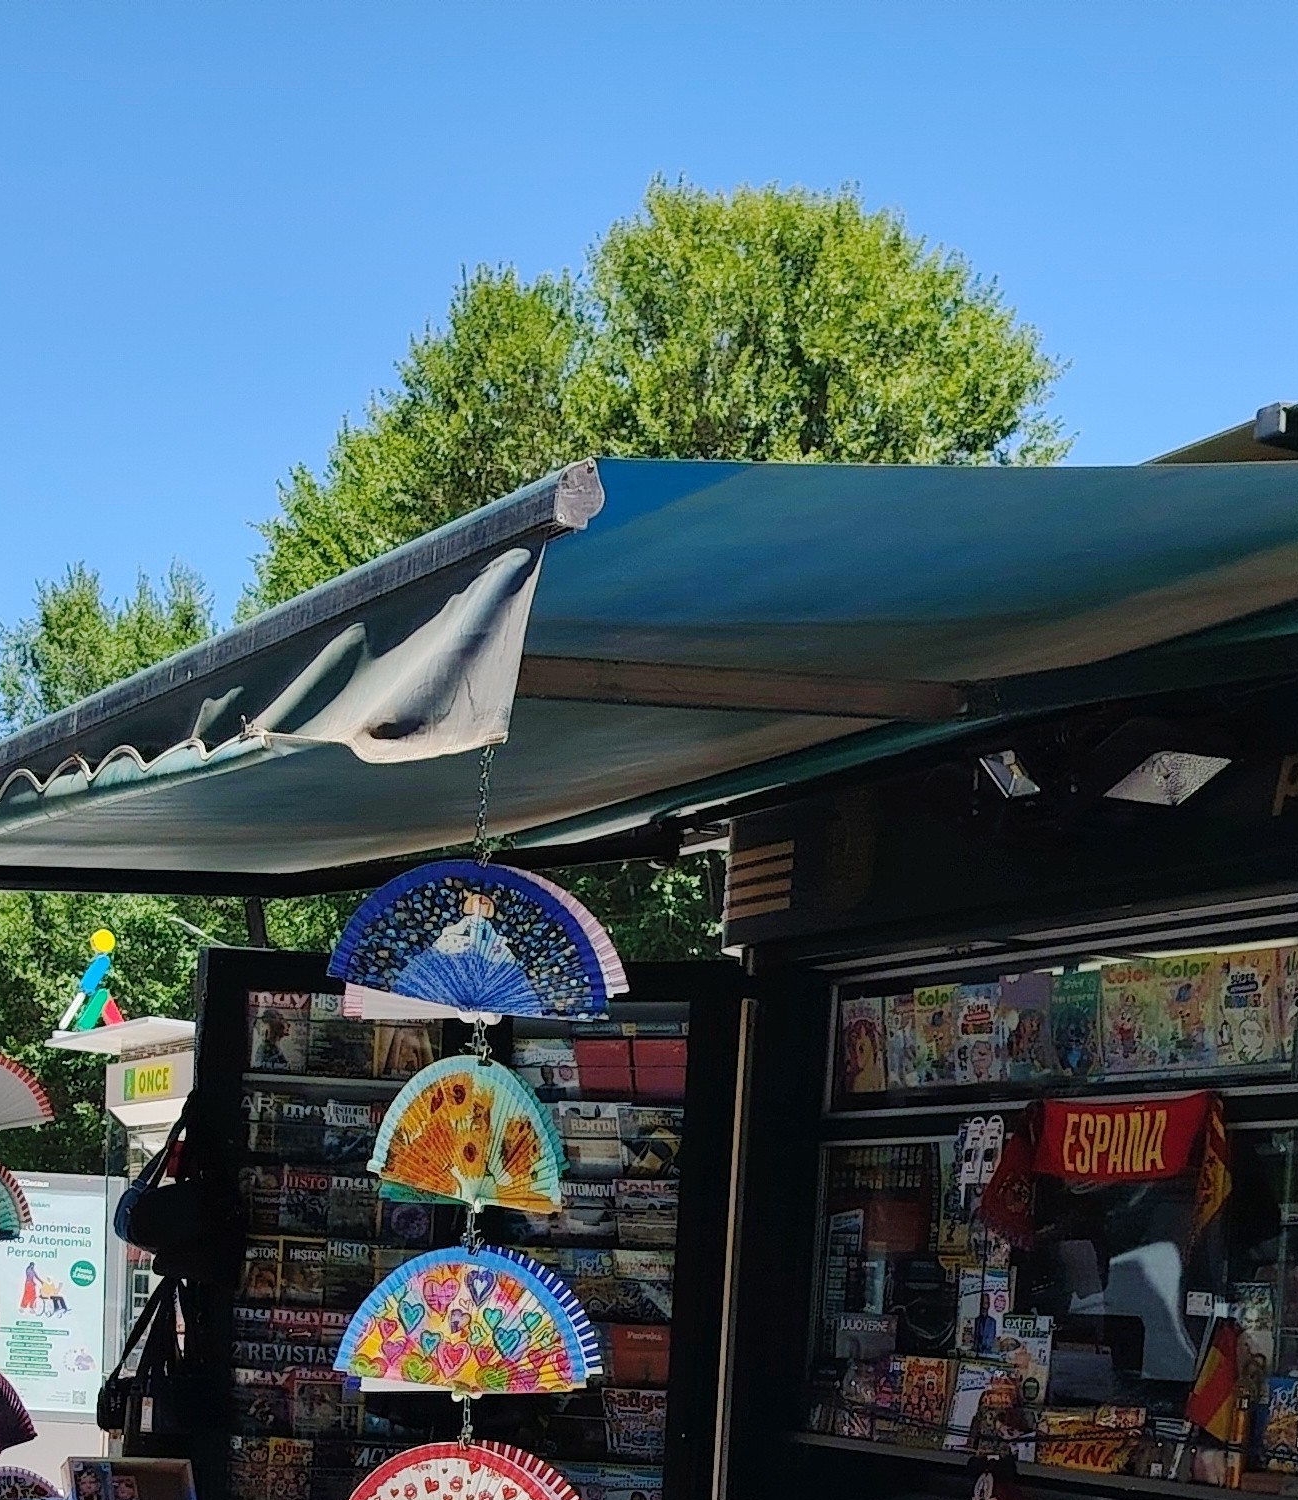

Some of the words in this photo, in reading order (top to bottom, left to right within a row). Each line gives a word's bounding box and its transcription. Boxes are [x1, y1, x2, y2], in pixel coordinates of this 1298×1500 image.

[138, 1067, 170, 1095] ONCE
[1062, 1106, 1167, 1174] ESPAÑA
[7, 1246, 58, 1258] Personal
[1004, 1318, 1035, 1329] extra
